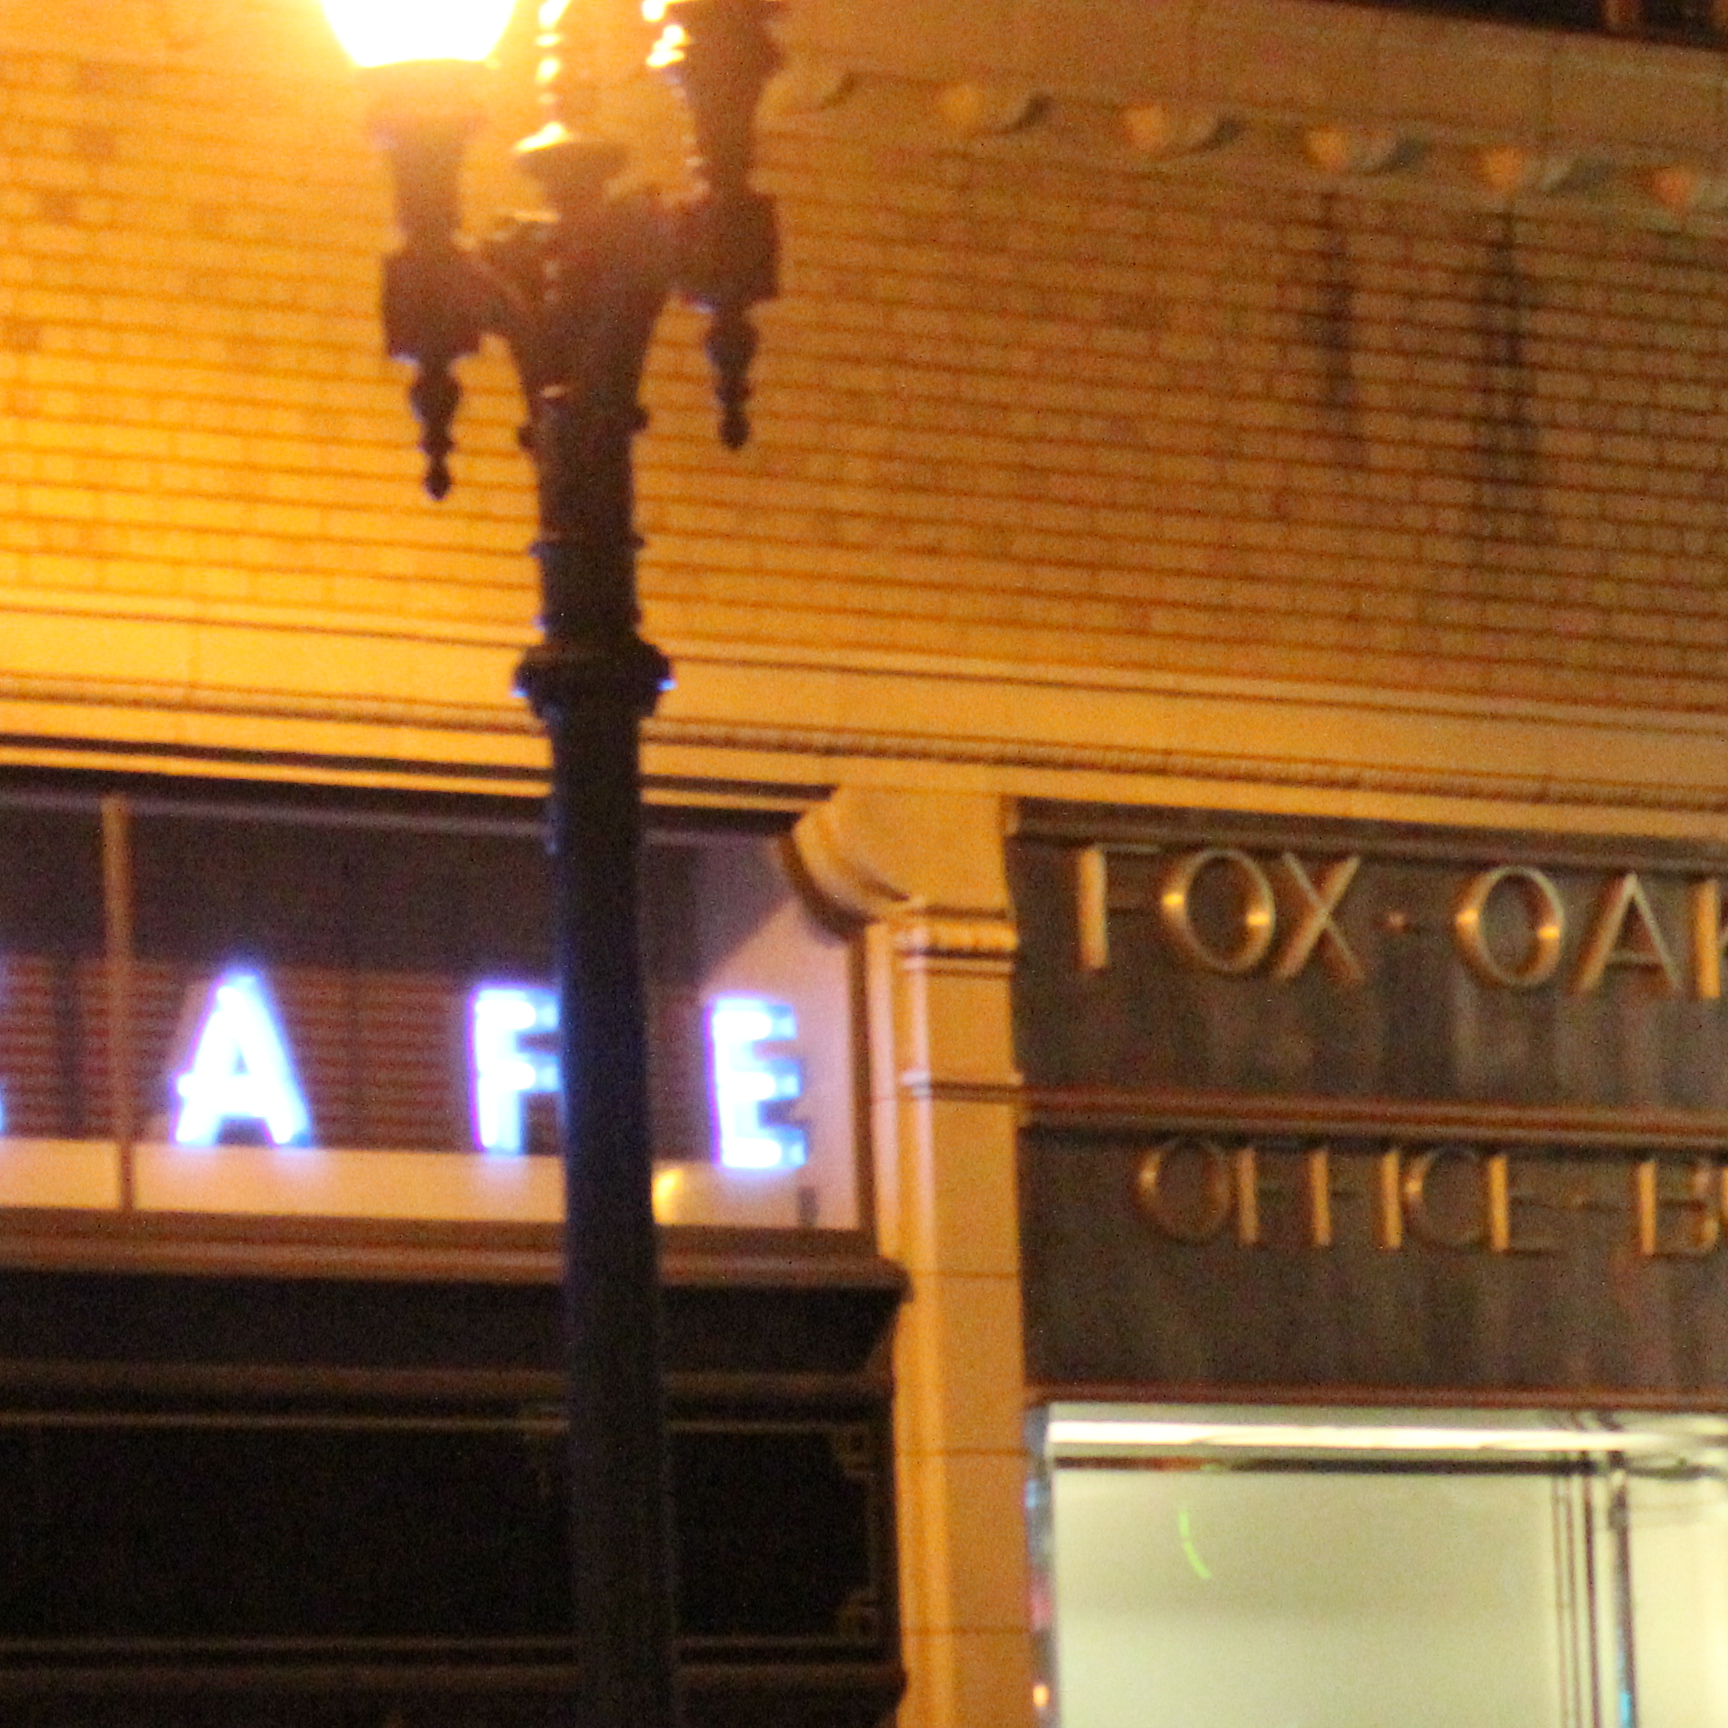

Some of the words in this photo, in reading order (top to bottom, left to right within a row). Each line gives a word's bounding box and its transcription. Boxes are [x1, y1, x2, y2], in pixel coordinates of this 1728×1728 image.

[1076, 843, 1368, 985] FOX
[0, 965, 810, 1171] AFE
[1133, 1137, 1560, 1256] OFFICE
